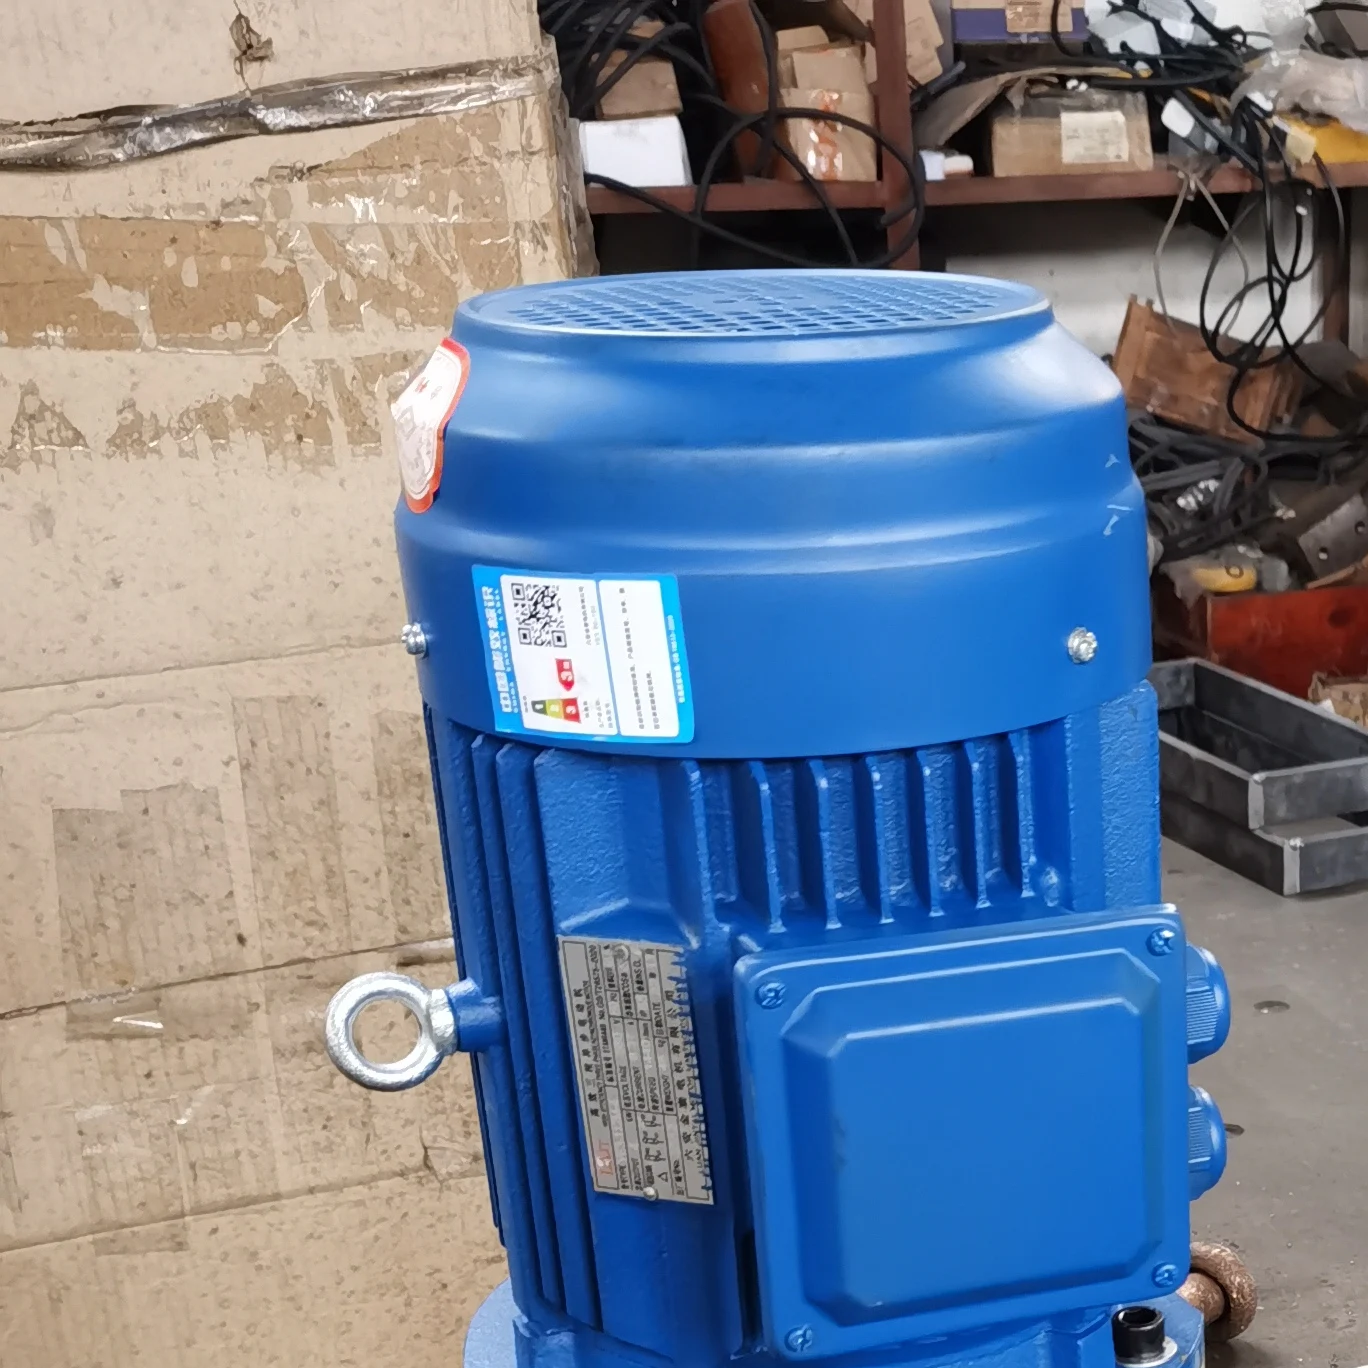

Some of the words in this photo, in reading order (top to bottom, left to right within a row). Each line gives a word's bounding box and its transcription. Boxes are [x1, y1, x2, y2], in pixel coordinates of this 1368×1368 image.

[481, 585, 512, 713] 中国能效标识
